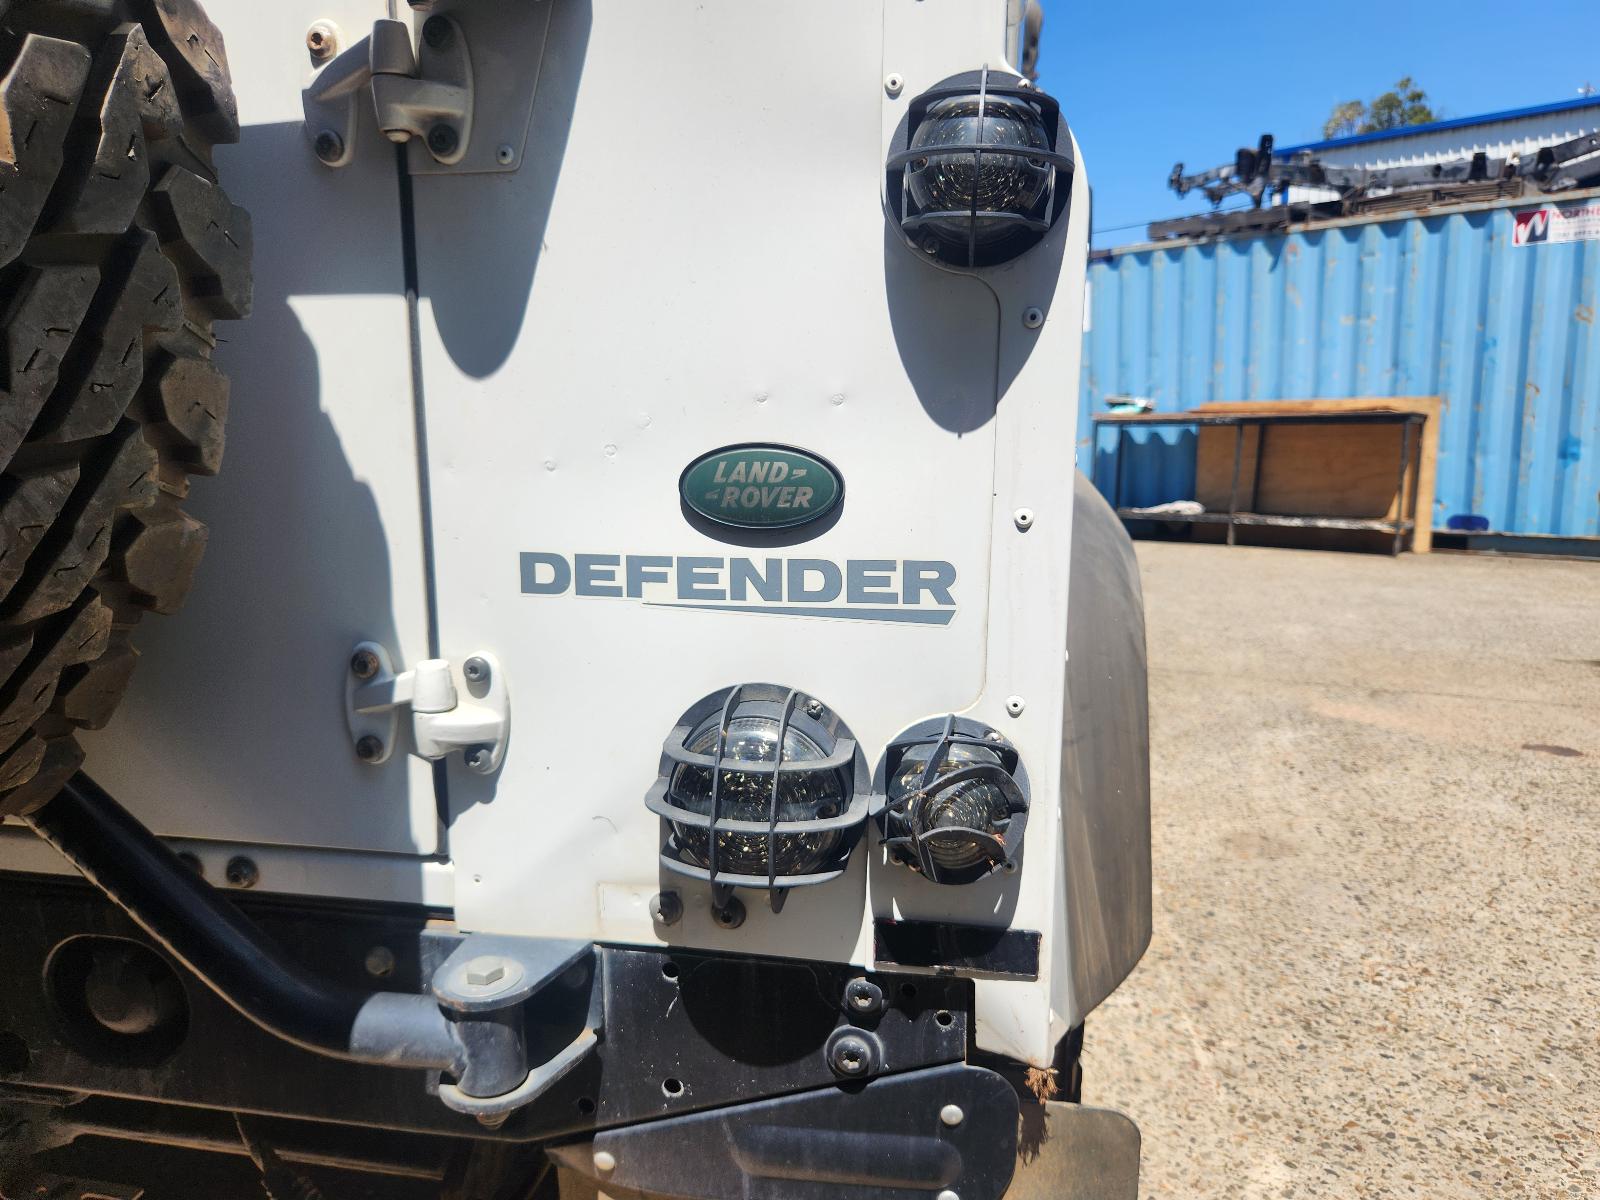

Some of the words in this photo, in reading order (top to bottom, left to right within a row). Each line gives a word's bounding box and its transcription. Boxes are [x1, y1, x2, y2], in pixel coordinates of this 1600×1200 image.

[713, 461, 789, 483] LAND
[720, 486, 814, 508] ROVER
[519, 551, 957, 606] DEFENDER
